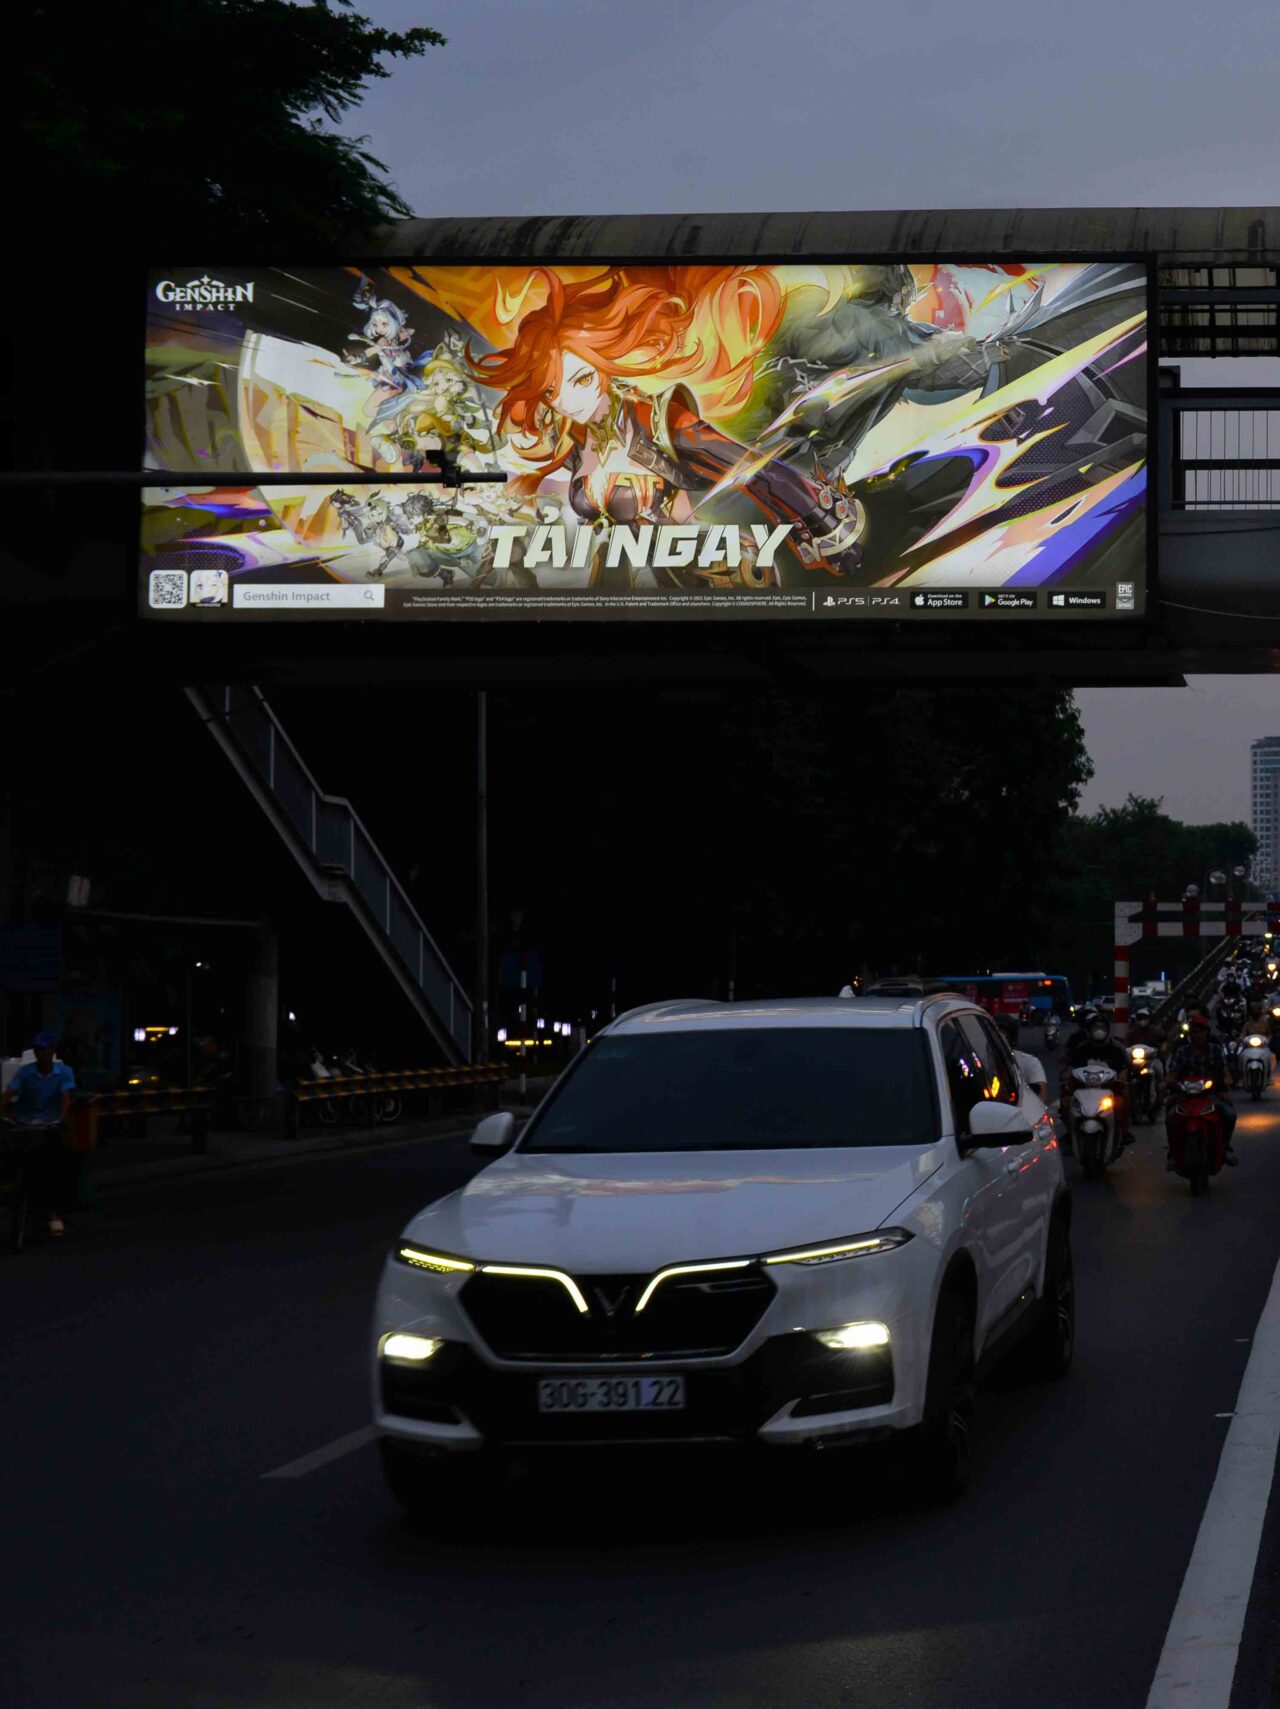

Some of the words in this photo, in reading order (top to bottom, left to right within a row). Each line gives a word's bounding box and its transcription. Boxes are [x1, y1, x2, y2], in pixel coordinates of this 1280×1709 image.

[156, 280, 255, 303] GENSHIN
[175, 303, 236, 311] IMPACT
[489, 505, 593, 568] TẢI
[605, 524, 793, 568] NGAY
[1118, 584, 1132, 593] EPIC
[243, 591, 288, 601] Genshin
[292, 591, 330, 603] Impact
[838, 597, 865, 605] PS5
[871, 597, 900, 605] PS4
[927, 598, 943, 607] App
[944, 598, 963, 606] Store
[997, 599, 1020, 607] Google
